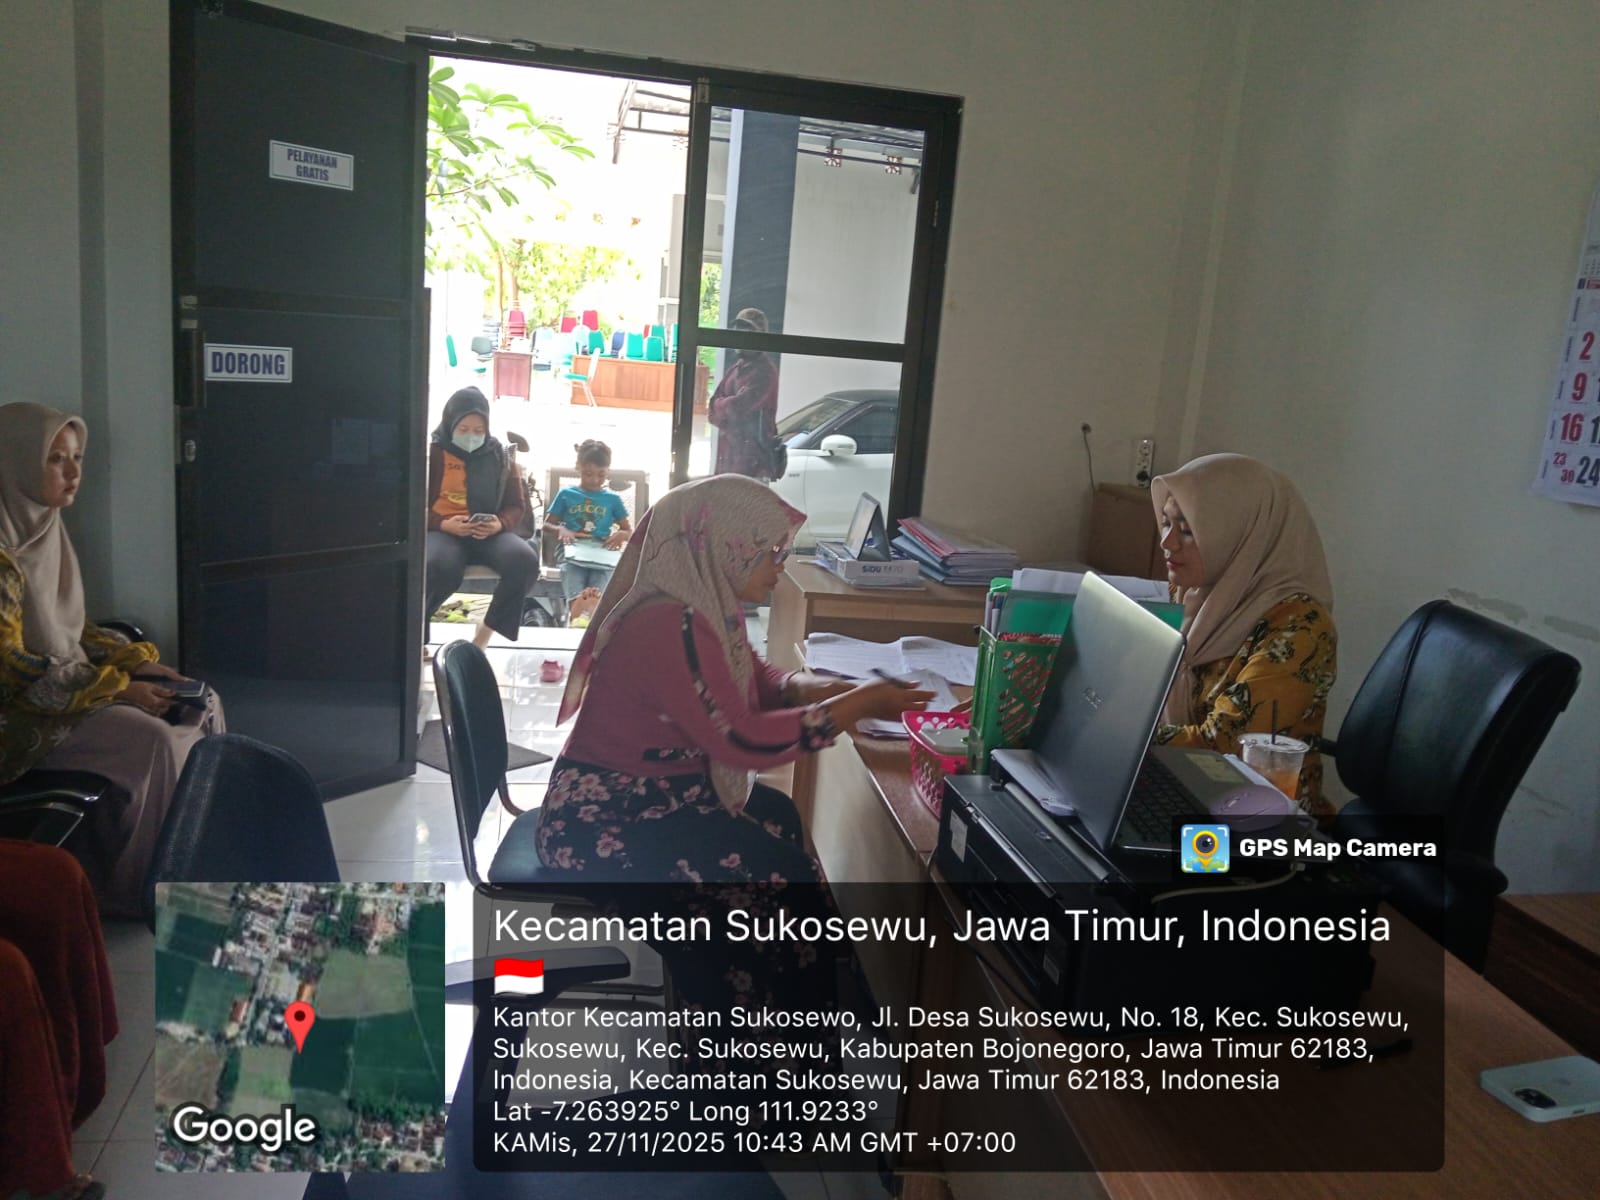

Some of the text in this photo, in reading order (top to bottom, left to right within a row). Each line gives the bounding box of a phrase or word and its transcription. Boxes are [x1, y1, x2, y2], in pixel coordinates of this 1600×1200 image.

[287, 148, 337, 168] PELAYANAN
[296, 165, 329, 181] GRATIS
[1579, 331, 1595, 361] 2
[211, 351, 285, 375] DORONG
[1572, 372, 1588, 401] 9
[1561, 412, 1584, 442] 16
[1553, 452, 1600, 487] 23 24
[1561, 469, 1575, 483] 30
